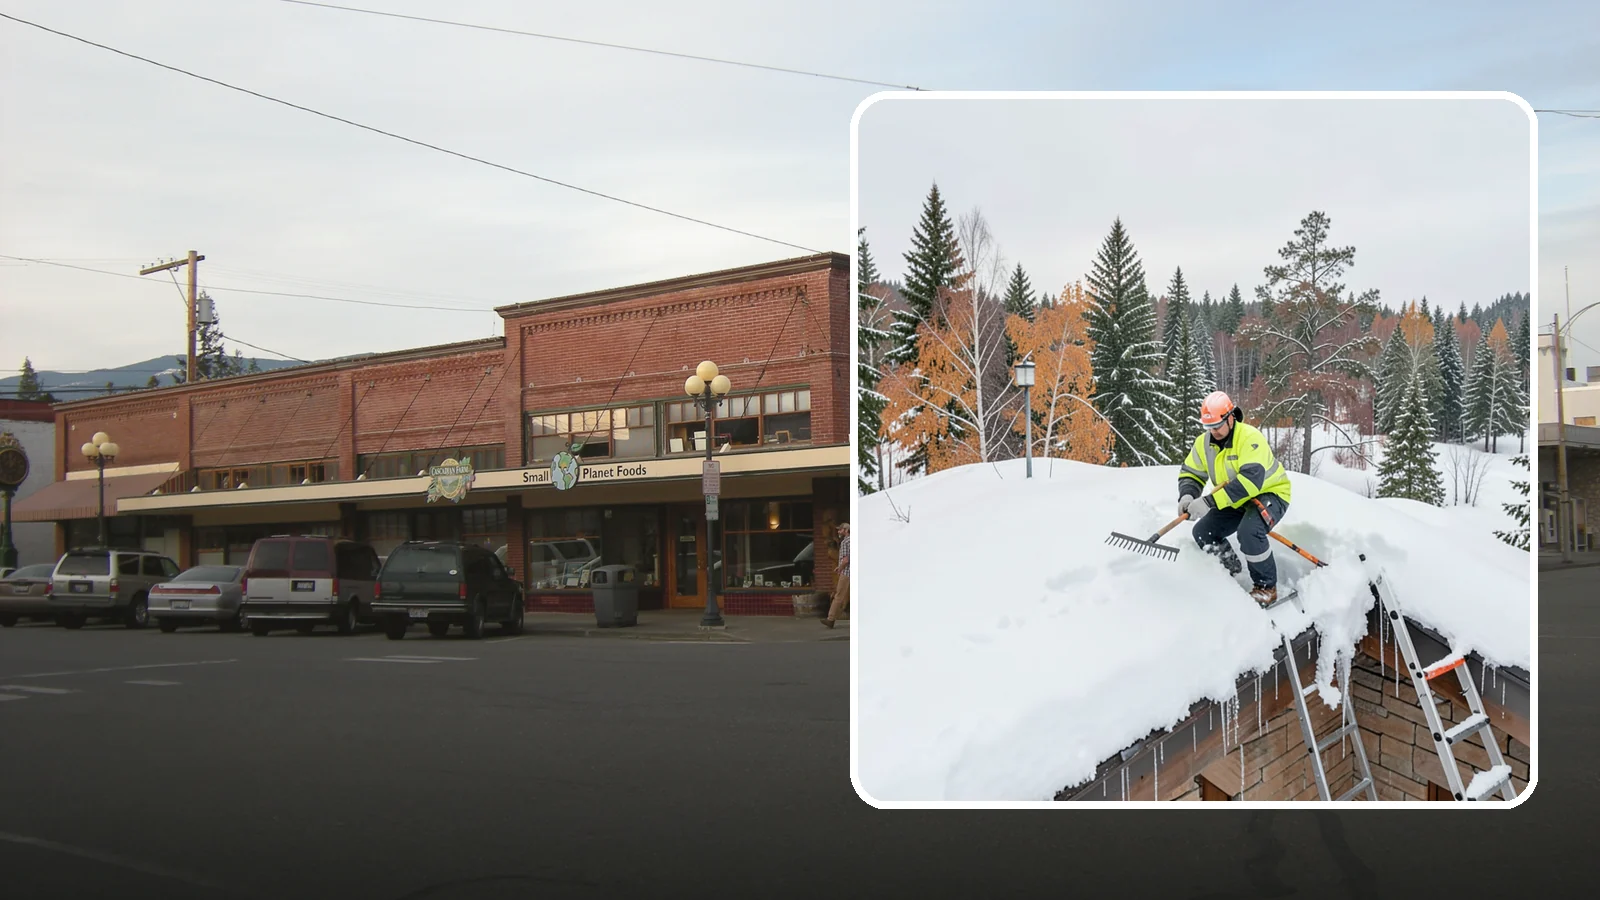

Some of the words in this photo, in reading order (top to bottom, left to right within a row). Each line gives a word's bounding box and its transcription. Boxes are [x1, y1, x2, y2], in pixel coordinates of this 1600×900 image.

[523, 470, 549, 483] Small
[583, 467, 614, 479] Planet
[617, 464, 647, 477] Foods
